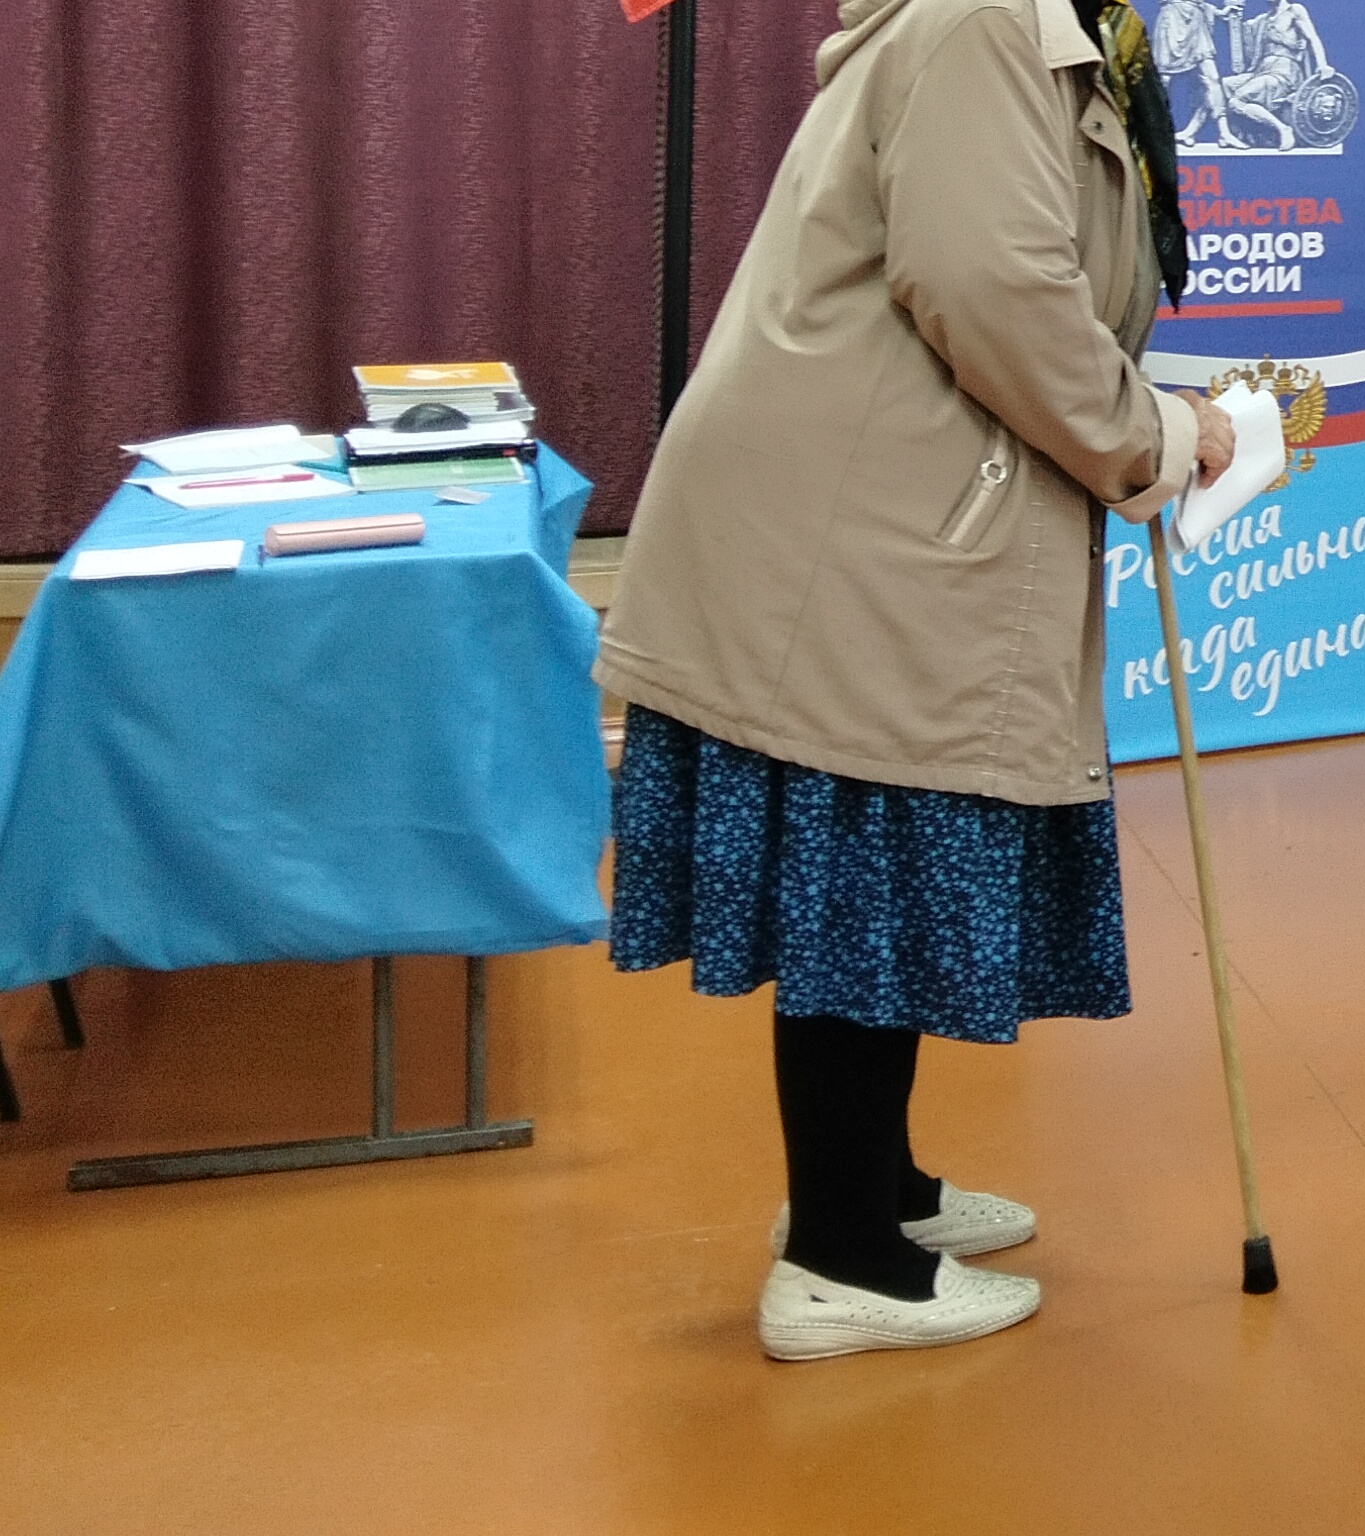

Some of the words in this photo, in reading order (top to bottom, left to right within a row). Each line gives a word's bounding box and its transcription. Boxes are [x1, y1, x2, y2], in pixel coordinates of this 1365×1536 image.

[1176, 165, 1222, 197] ОД
[1177, 198, 1343, 232] ДИНСТВА
[1186, 231, 1325, 264] РОДОВ
[1160, 265, 1301, 296] ССИИ
[1124, 616, 1257, 700] когда
